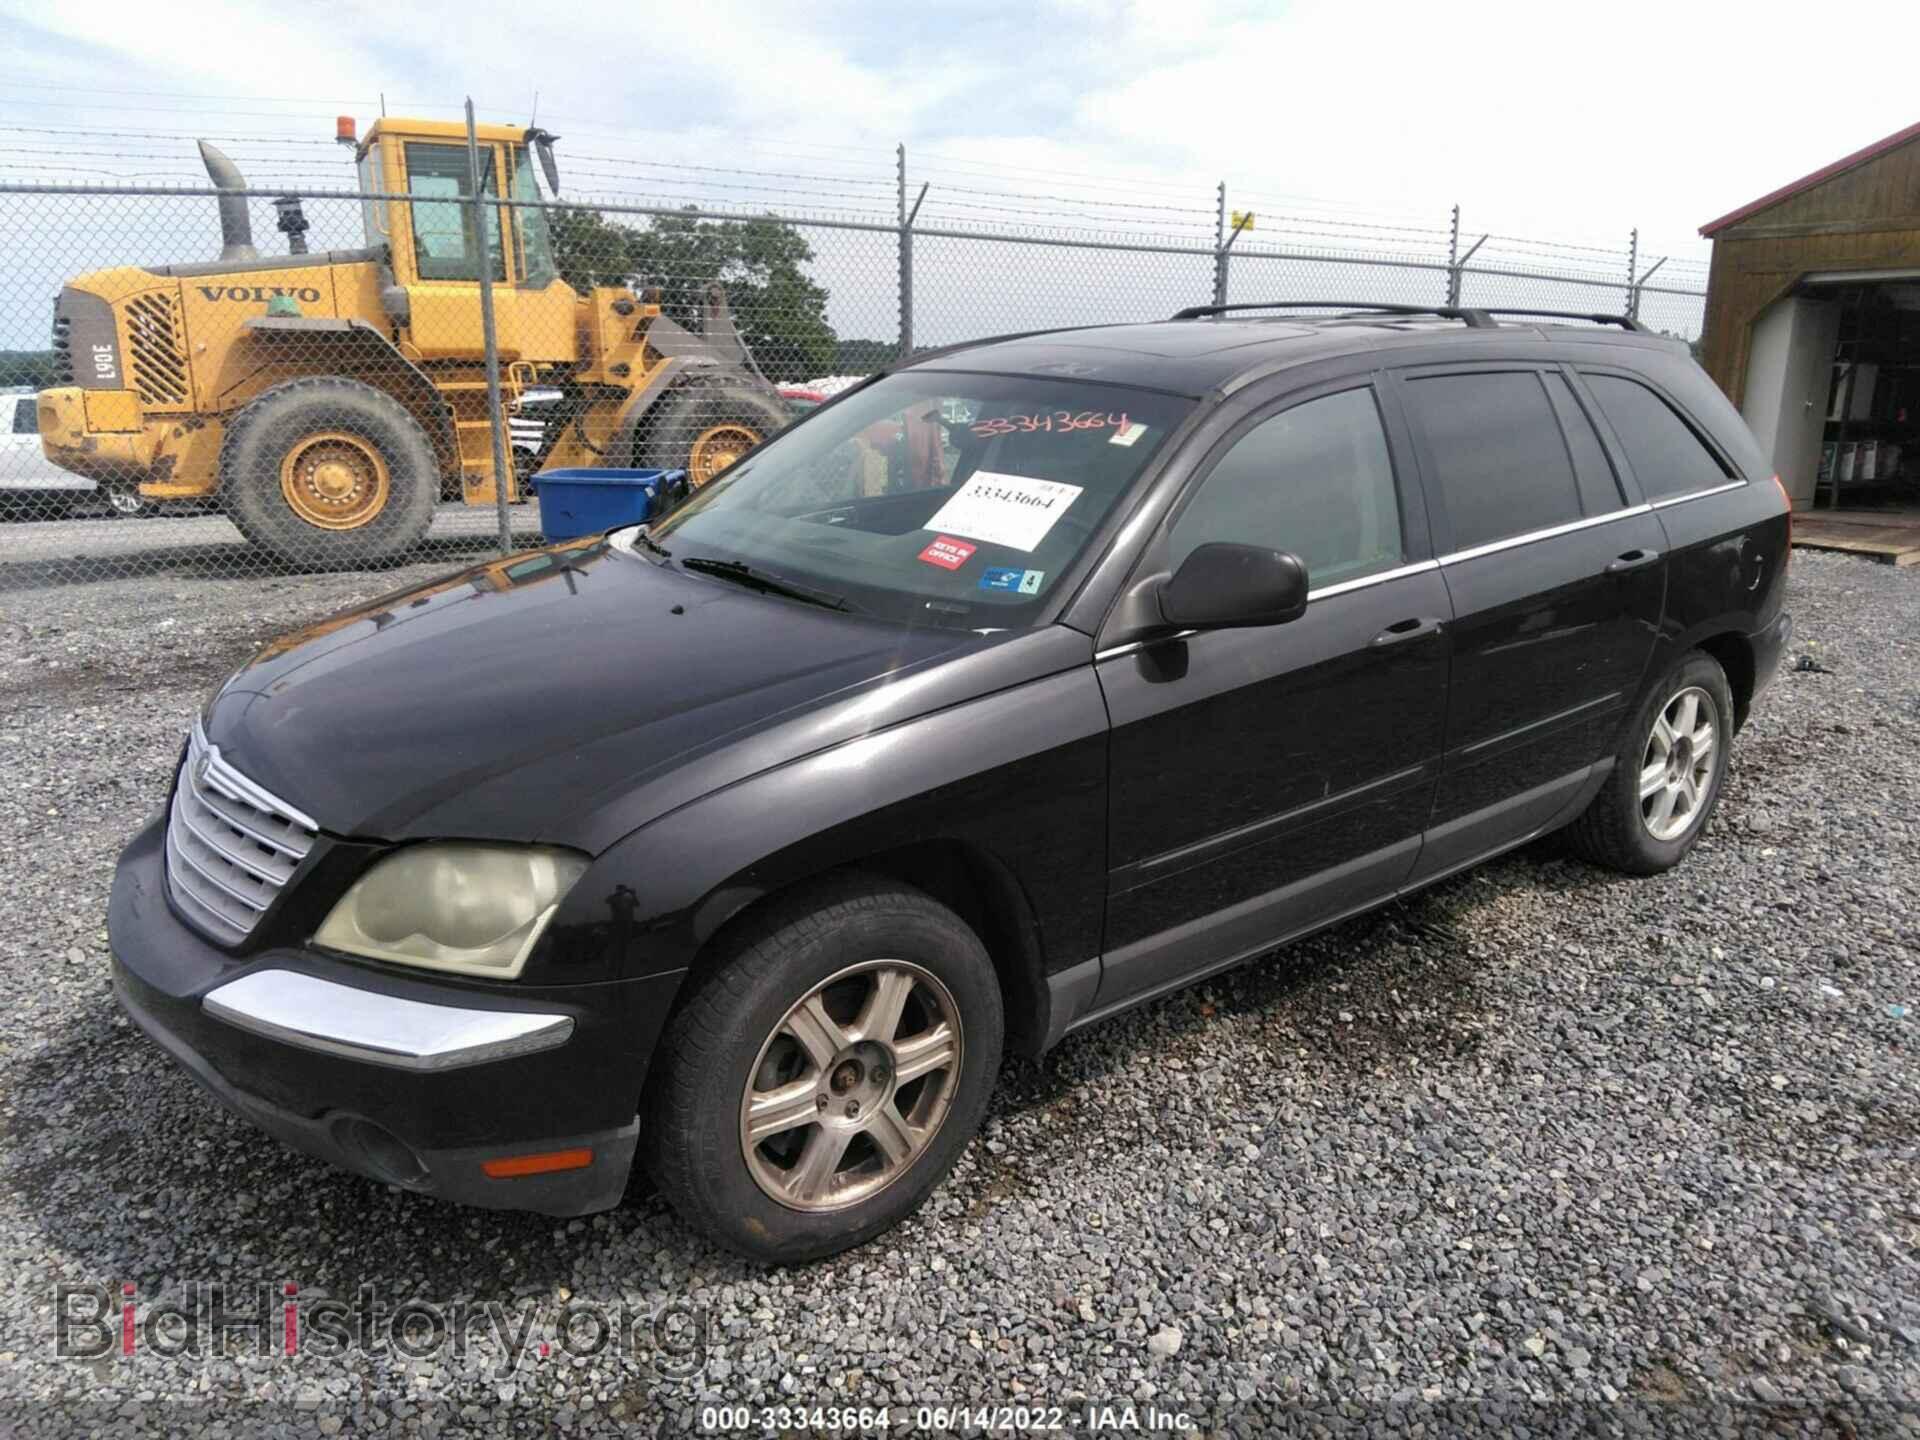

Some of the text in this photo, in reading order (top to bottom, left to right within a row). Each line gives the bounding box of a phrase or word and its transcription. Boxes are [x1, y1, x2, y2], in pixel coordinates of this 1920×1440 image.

[196, 286, 321, 302] VOLVO
[92, 344, 116, 379] L90E
[970, 411, 1130, 438] 33343664
[928, 549, 960, 564] OFFICE
